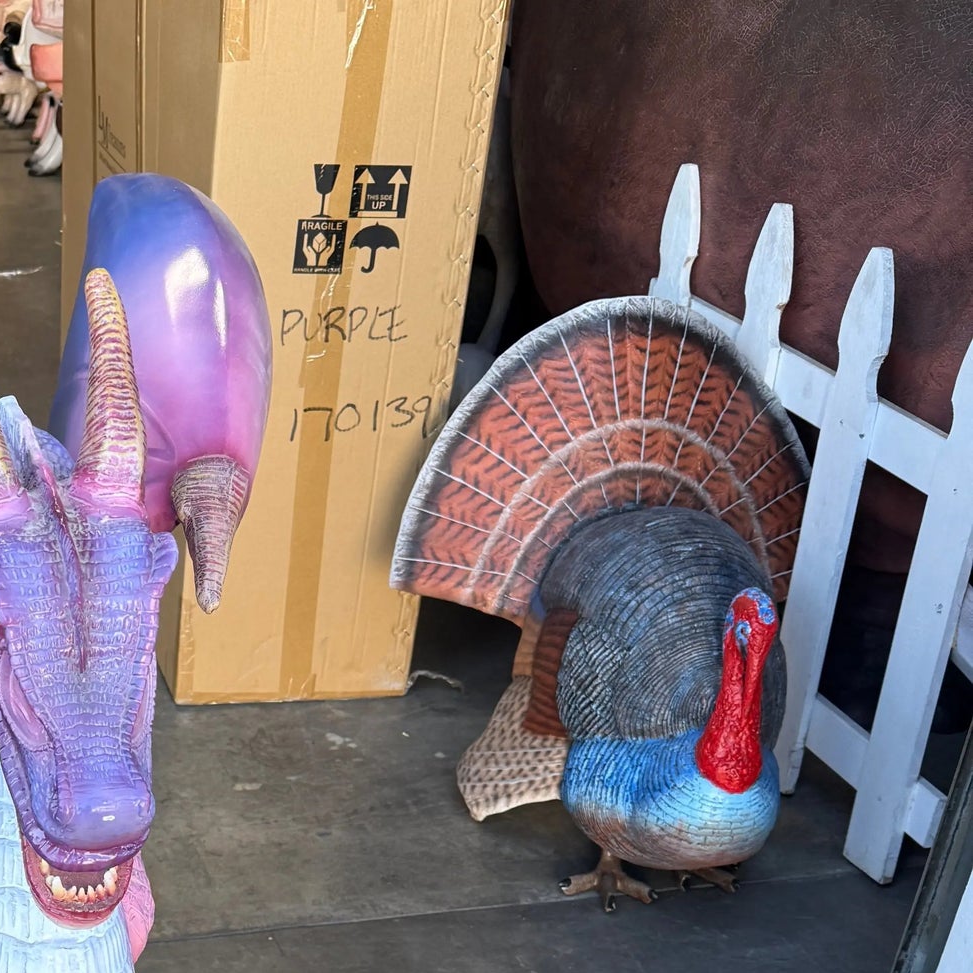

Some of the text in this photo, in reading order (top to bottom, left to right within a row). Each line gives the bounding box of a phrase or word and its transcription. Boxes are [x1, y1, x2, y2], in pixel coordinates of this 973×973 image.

[371, 201, 386, 210] UP
[301, 221, 343, 231] FRAGILE
[281, 304, 408, 346] PURPLE
[289, 396, 432, 442] 170139
